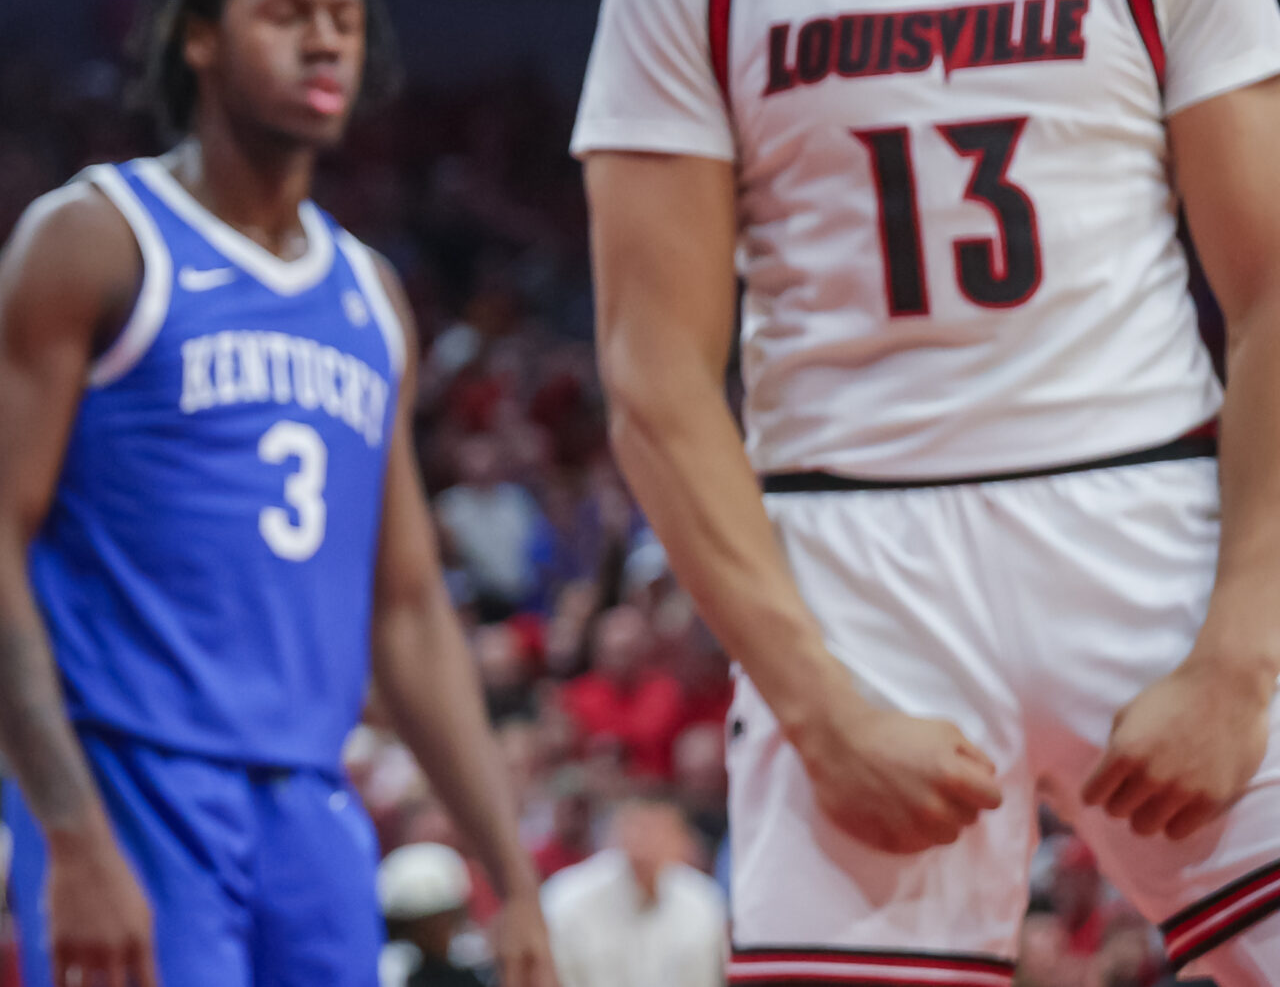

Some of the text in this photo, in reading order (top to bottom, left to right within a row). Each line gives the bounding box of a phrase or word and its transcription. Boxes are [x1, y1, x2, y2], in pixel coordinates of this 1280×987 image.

[848, 116, 1043, 320] 13
[180, 330, 389, 448] KENTUCKY
[257, 419, 328, 562] 3
